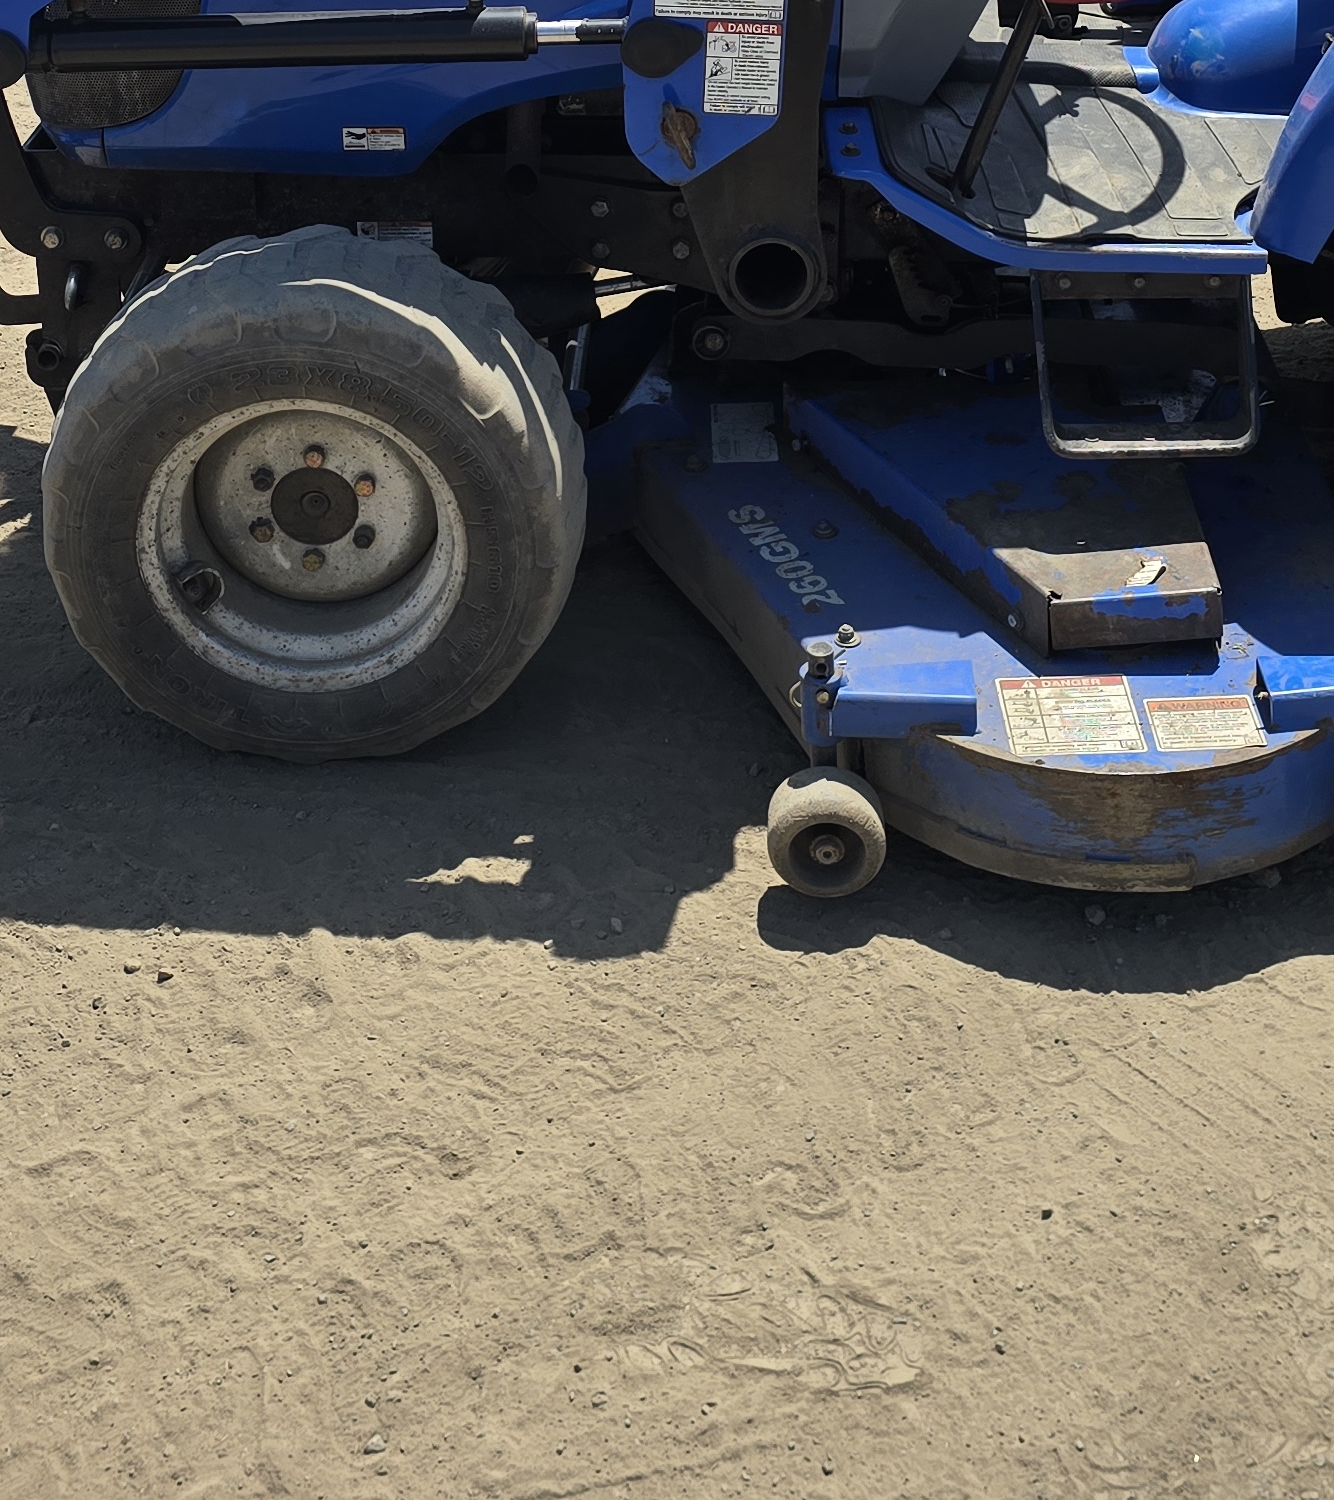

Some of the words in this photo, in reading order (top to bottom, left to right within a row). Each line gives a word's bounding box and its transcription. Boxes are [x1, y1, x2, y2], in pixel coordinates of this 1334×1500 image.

[727, 23, 778, 35] DANGER
[727, 504, 845, 605] 260GMS
[141, 650, 252, 726] TIRON
[1041, 677, 1101, 688] DANGER
[1170, 701, 1242, 711] WARNING
